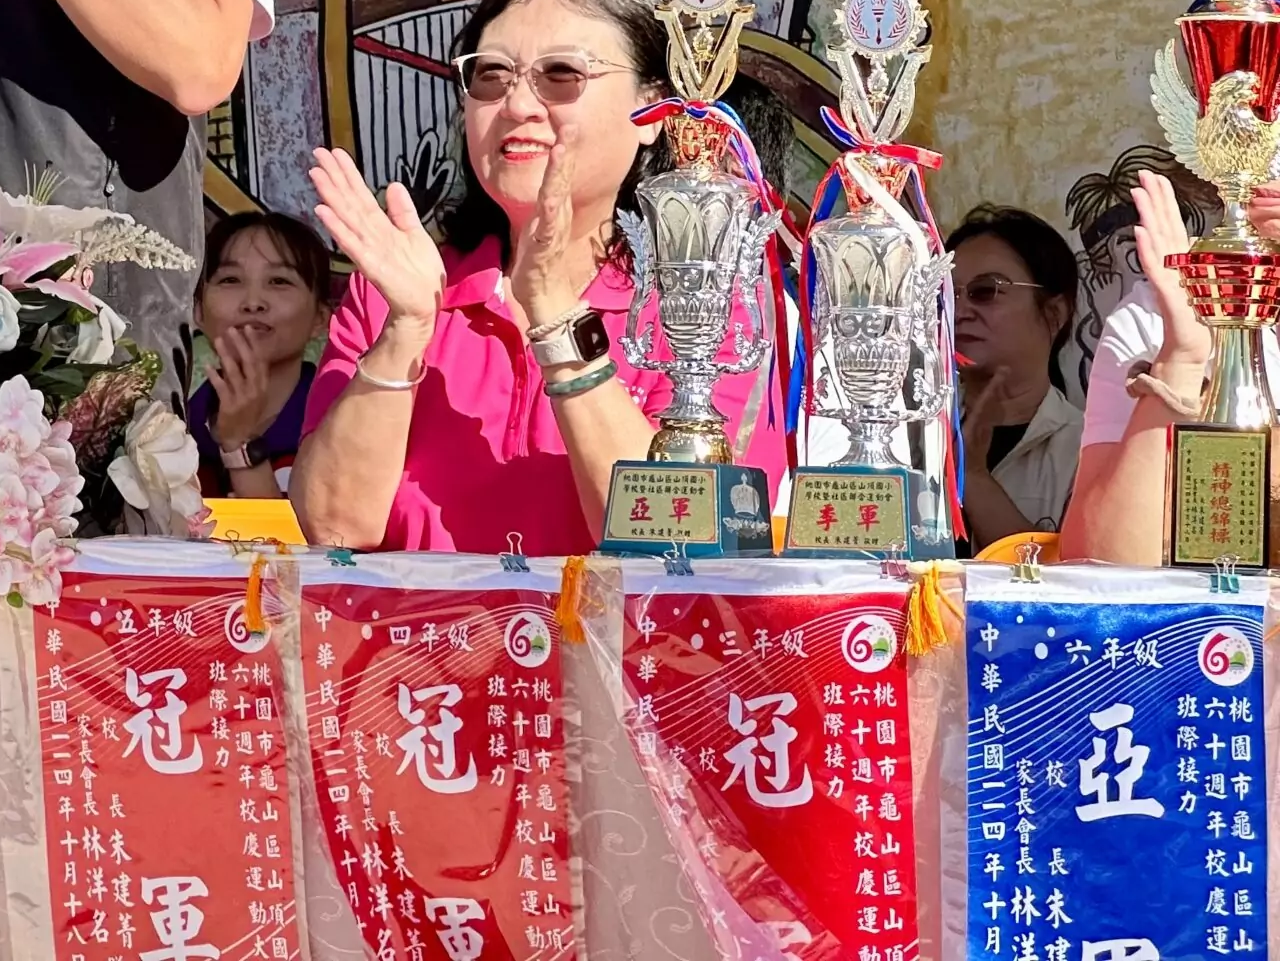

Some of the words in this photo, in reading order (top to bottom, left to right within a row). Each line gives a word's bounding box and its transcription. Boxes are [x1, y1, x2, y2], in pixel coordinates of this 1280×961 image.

[629, 497, 691, 524] 亞軍
[816, 503, 880, 532] 季軍
[117, 608, 198, 638] 五年級
[388, 622, 475, 653] 四年級
[718, 627, 811, 660] 三年級
[1064, 637, 1164, 671] 六年級
[209, 660, 231, 769] 班際接力
[487, 676, 508, 787] 班際接力
[823, 683, 847, 800] 班際接力
[980, 622, 1006, 954] 中華民國一一四年十月
[1176, 693, 1200, 815] 班際接力
[122, 667, 221, 961] 冠軍
